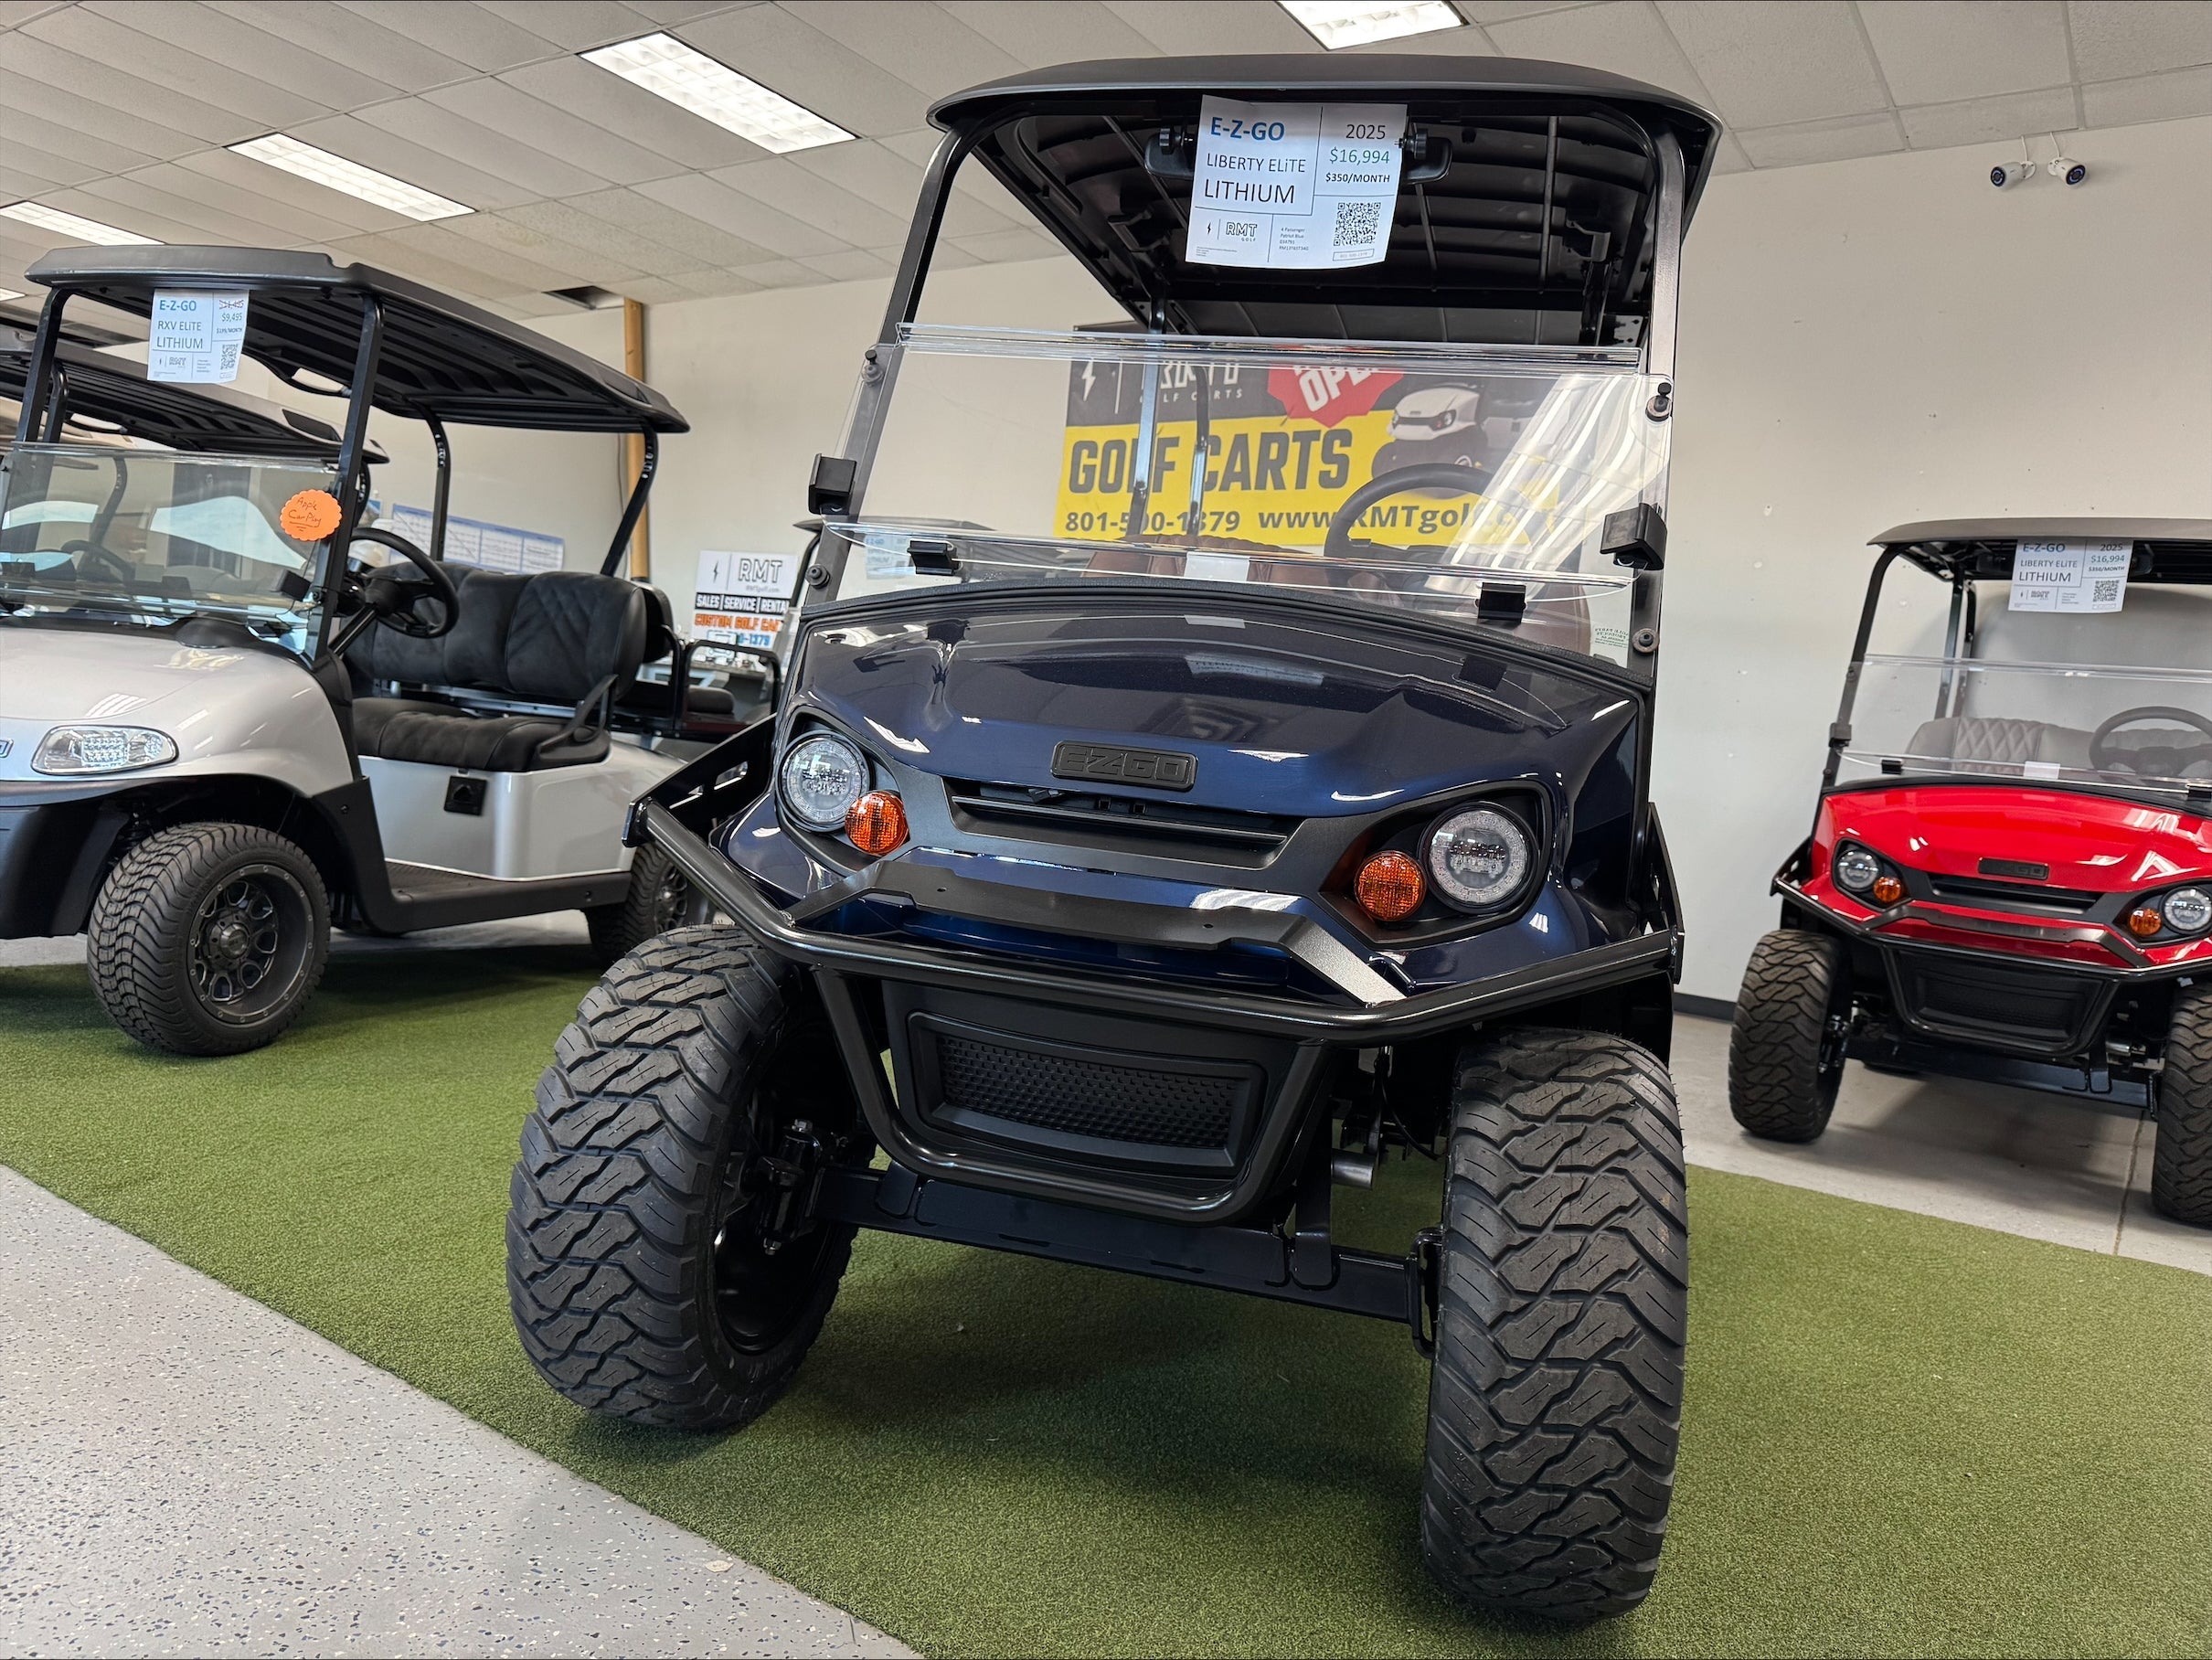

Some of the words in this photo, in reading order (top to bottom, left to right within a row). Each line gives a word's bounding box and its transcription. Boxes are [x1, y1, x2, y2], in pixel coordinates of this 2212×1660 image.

[1210, 117, 1285, 141] E-Z-GO
[1345, 123, 1386, 140] 2025
[1207, 153, 1265, 172] LIBERTY
[1329, 146, 1390, 165] $16,994
[1325, 172, 1390, 183] $350/MONTH
[1205, 178, 1295, 204] LITHIUM
[1226, 221, 1258, 237] RMT
[159, 300, 197, 312] E-Z-GO
[157, 320, 176, 330] RXV
[156, 336, 203, 349] LITHIUM
[1191, 388, 1243, 401] CRTS
[297, 497, 318, 511] Apple
[2023, 543, 2066, 553] E-Z-GO
[2100, 543, 2123, 552] 2025
[2020, 559, 2054, 568] LIBERTY
[2090, 554, 2125, 563] $16,994
[739, 558, 783, 583] RMT
[2019, 571, 2071, 582] LITHIUM
[697, 594, 720, 609] SALES
[723, 596, 757, 612] SERVICE
[695, 613, 732, 629] CUSTOM
[735, 616, 760, 631] GOLF
[1058, 746, 1189, 782] EZGO
